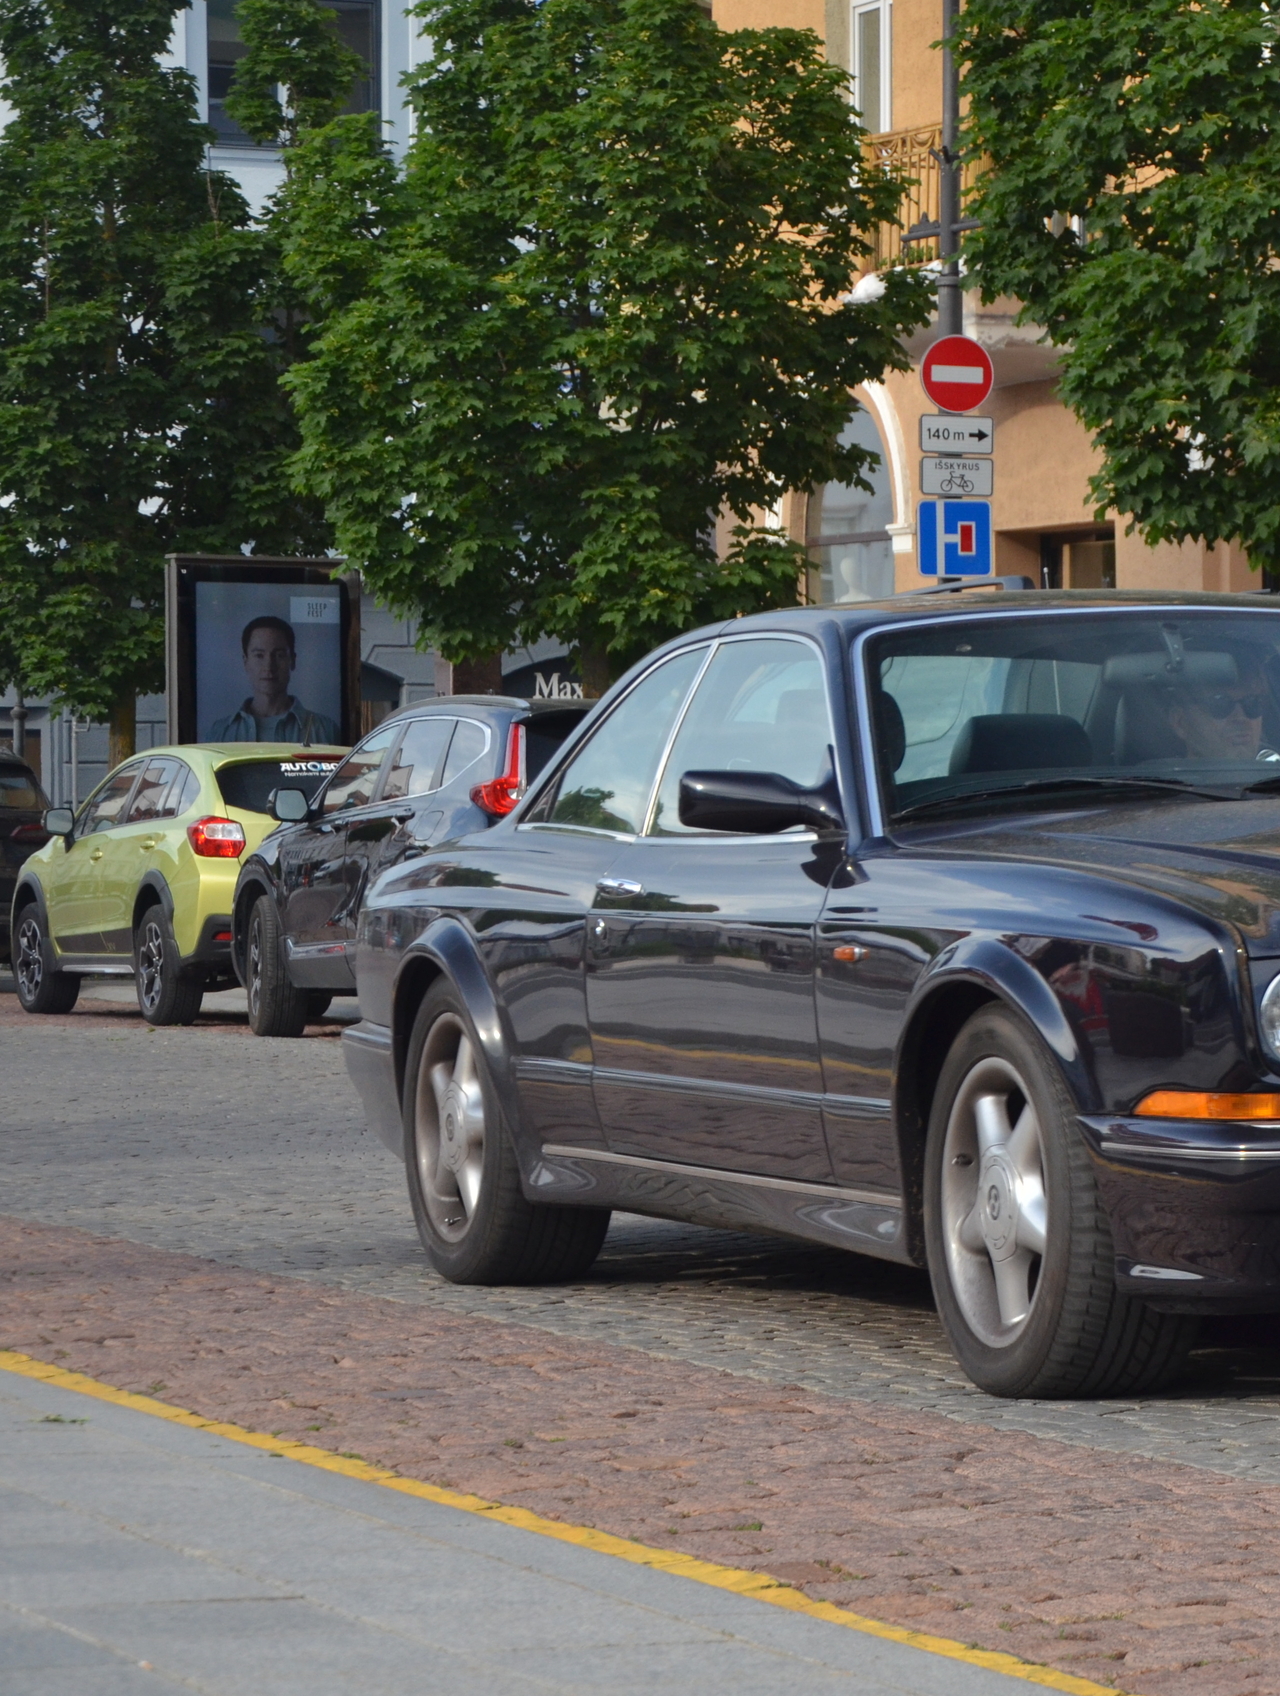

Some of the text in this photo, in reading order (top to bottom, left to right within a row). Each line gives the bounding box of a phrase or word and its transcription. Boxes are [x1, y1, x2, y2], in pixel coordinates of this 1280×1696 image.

[927, 427, 965, 441] 140 m
[934, 460, 980, 471] IŠSKYRUS
[307, 602, 327, 610] SLEEP
[532, 672, 584, 700] Max
